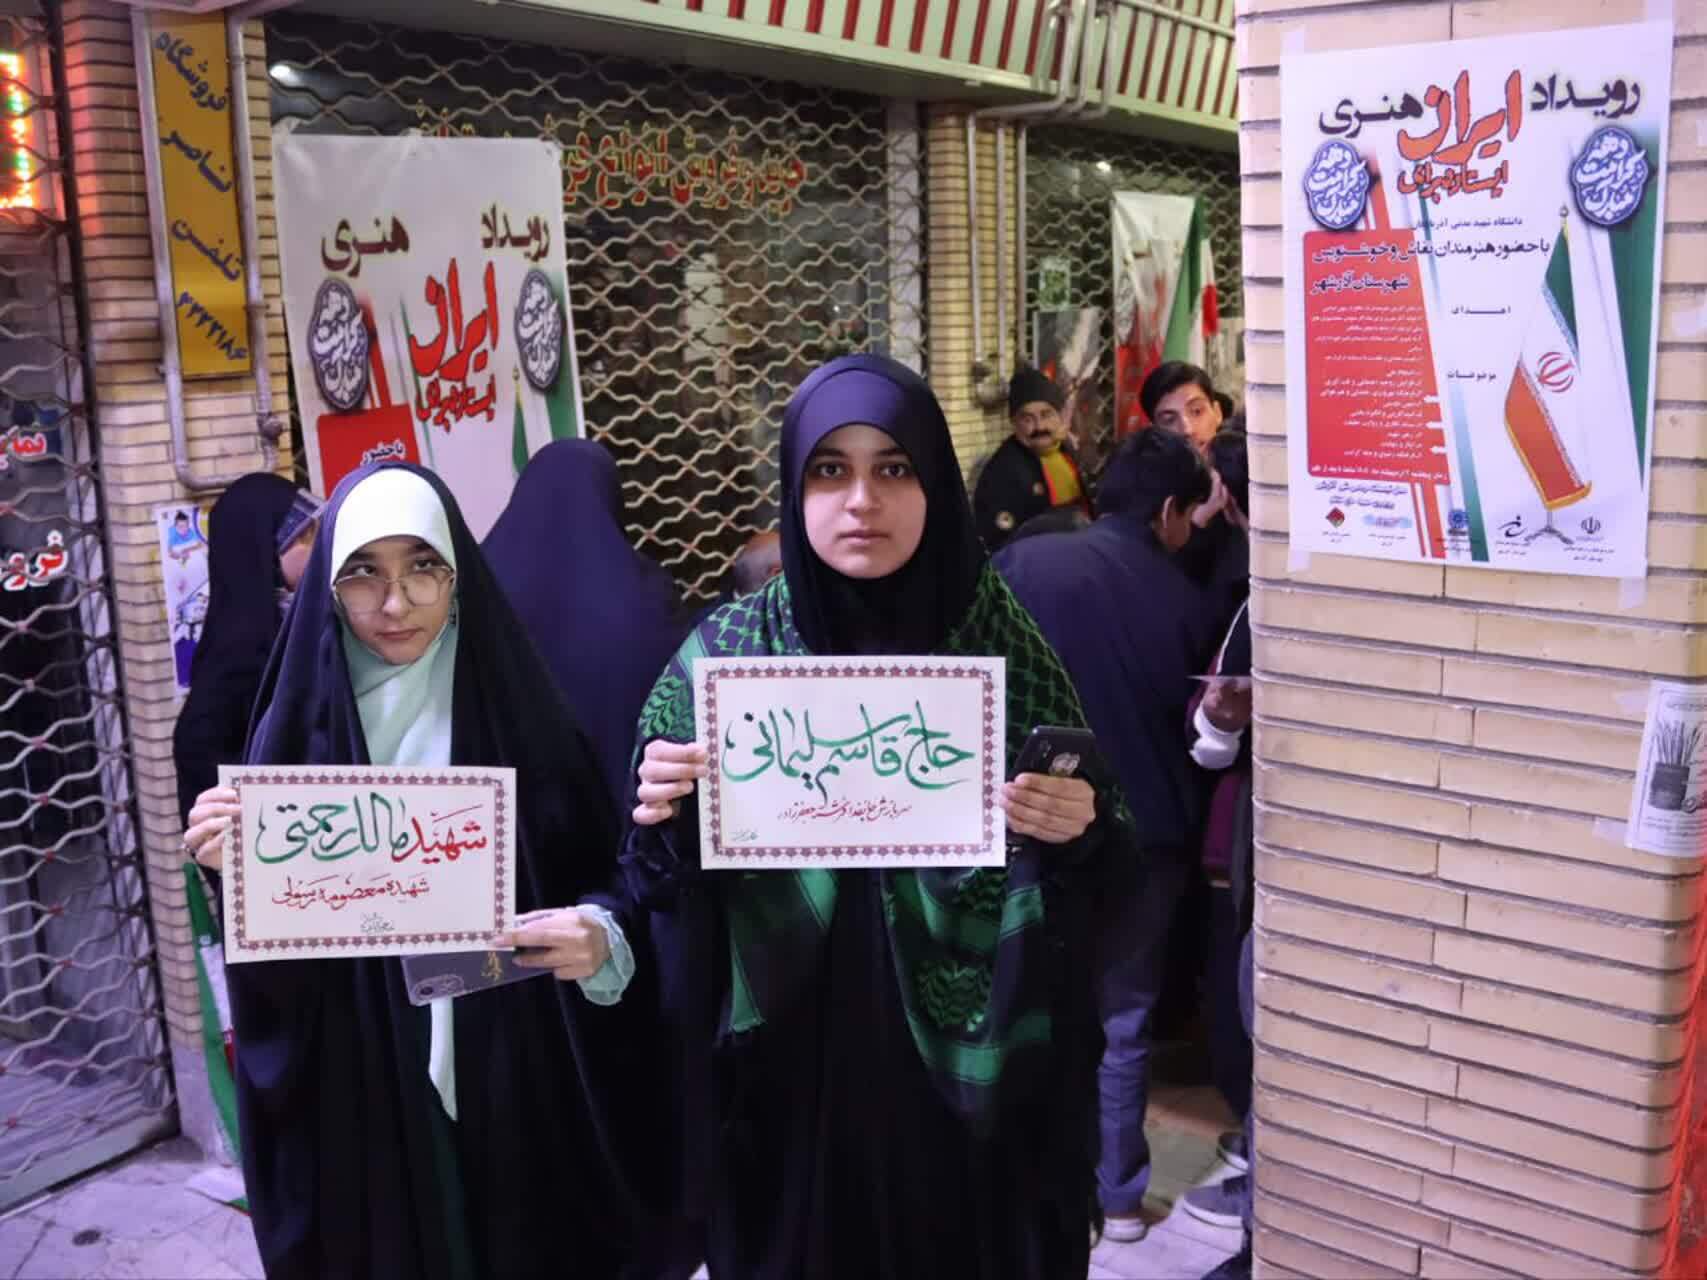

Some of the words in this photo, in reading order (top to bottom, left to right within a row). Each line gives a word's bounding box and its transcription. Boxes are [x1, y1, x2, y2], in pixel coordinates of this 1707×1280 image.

[155, 30, 229, 112] فروشگاه
[1530, 73, 1641, 119] رویداد
[1318, 93, 1424, 138] هنری
[1397, 69, 1523, 165] ایران
[160, 130, 234, 193] ناصر
[171, 218, 243, 281] تلفن
[320, 215, 410, 278] هنری
[480, 203, 550, 262] رویداد
[1388, 243, 1399, 263] و
[1434, 240, 1496, 261] هنرمندان
[1497, 241, 1540, 260] حضور
[1540, 237, 1551, 257] با
[1352, 272, 1410, 295] شهرستان
[408, 256, 499, 382] ایران
[721, 707, 912, 791] سلیمانی
[814, 703, 904, 802] قاسم
[904, 699, 976, 790] حاج
[255, 800, 358, 865] رحمتی
[390, 803, 489, 865] شهید
